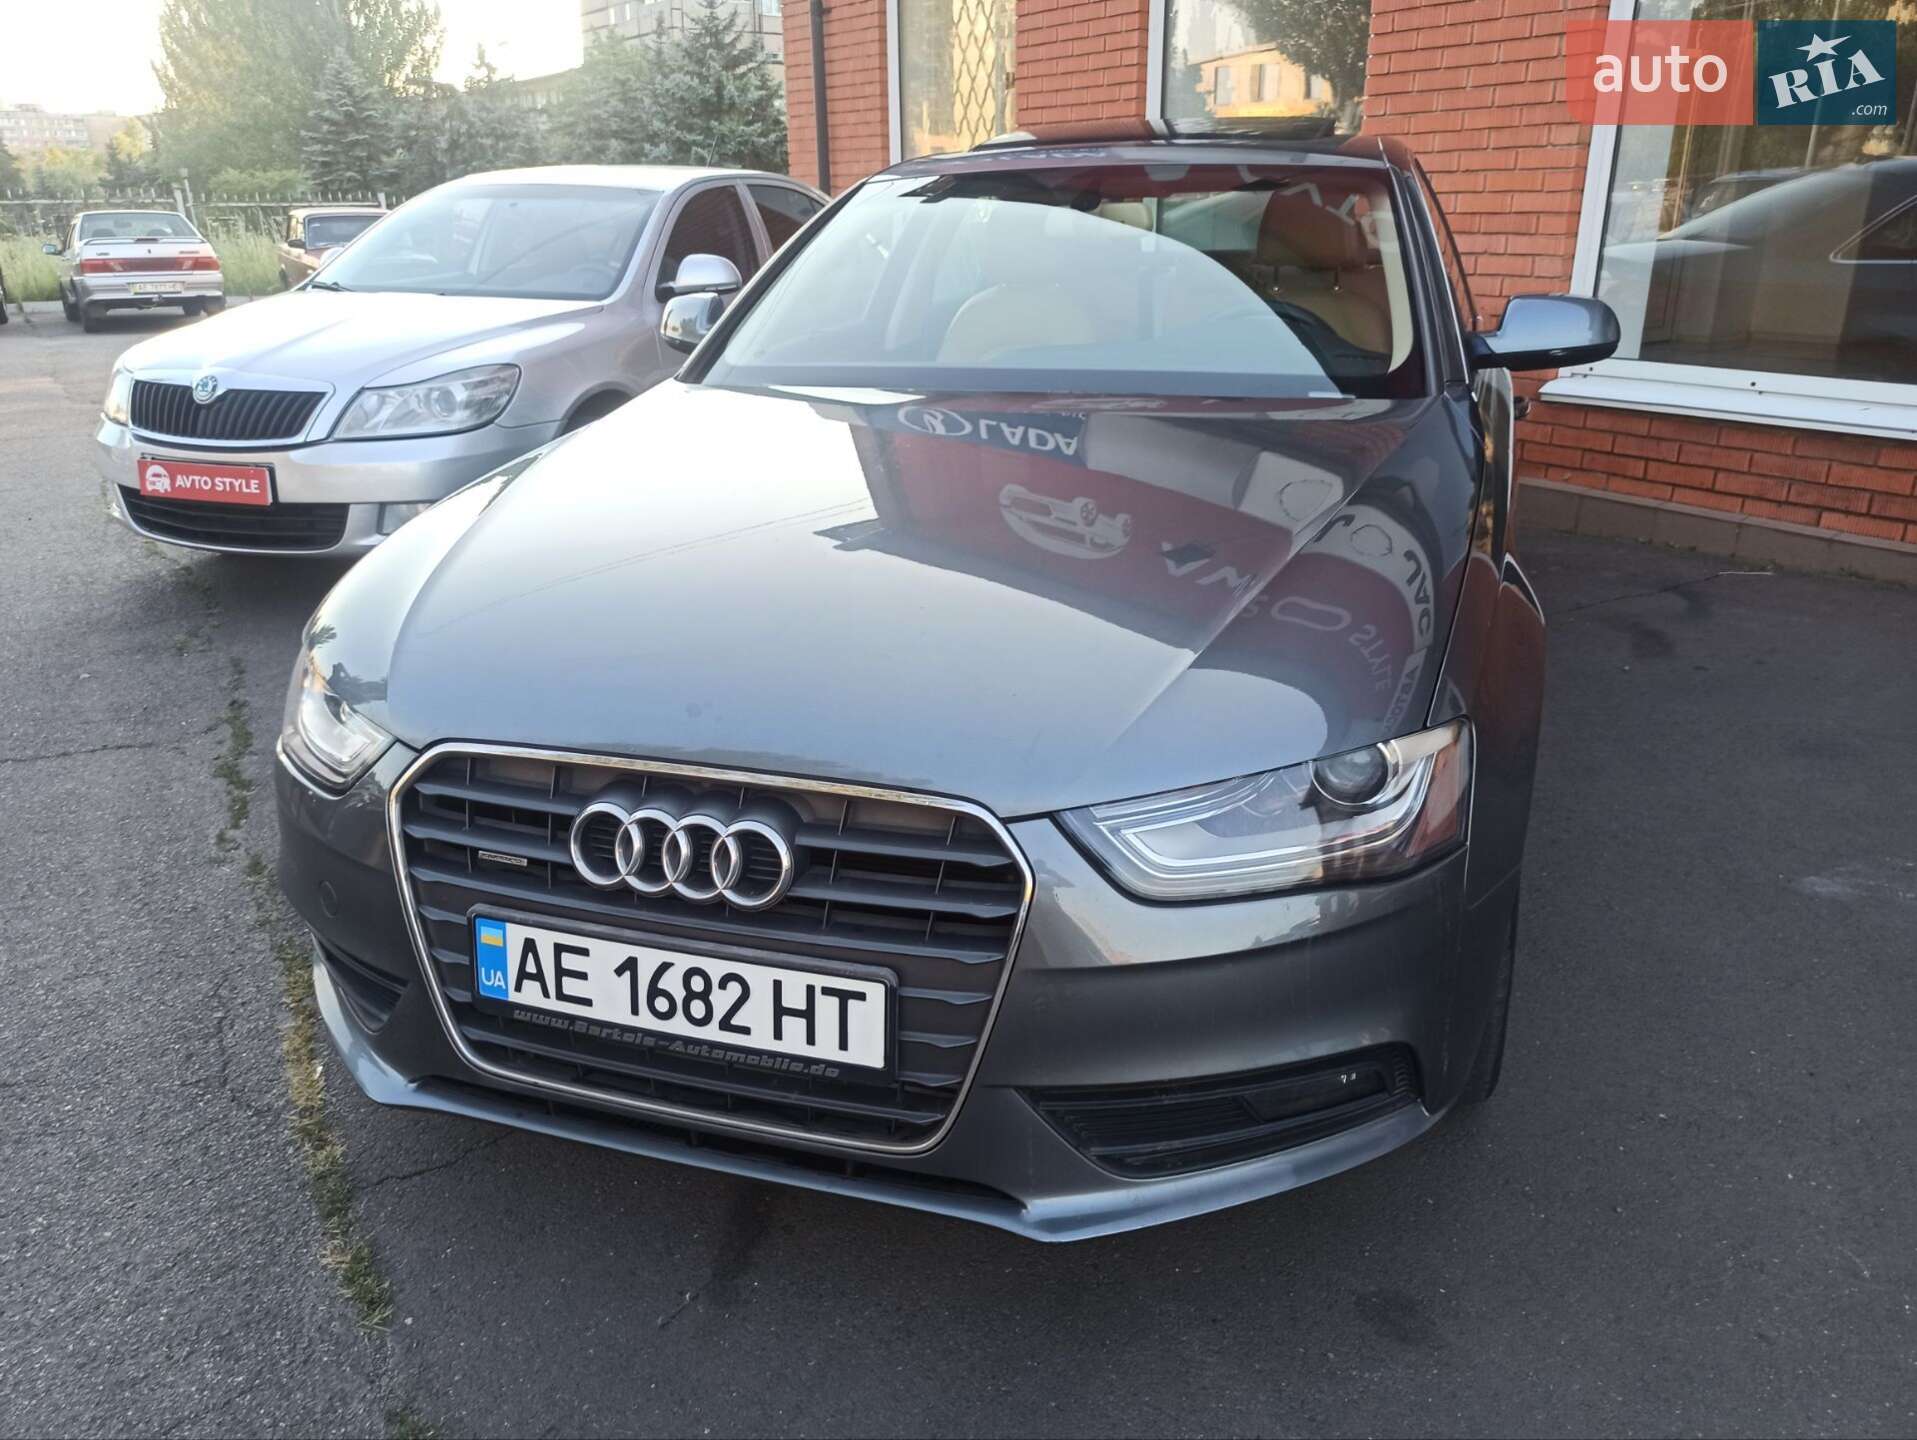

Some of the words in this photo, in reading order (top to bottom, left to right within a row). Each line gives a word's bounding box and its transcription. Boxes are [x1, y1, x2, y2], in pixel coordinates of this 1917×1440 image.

[175, 475, 212, 490] AVTO
[215, 477, 260, 493] STYLE
[481, 967, 506, 990] UA
[513, 937, 593, 1007] AE
[613, 956, 752, 1035] 1682
[773, 978, 868, 1052] HT
